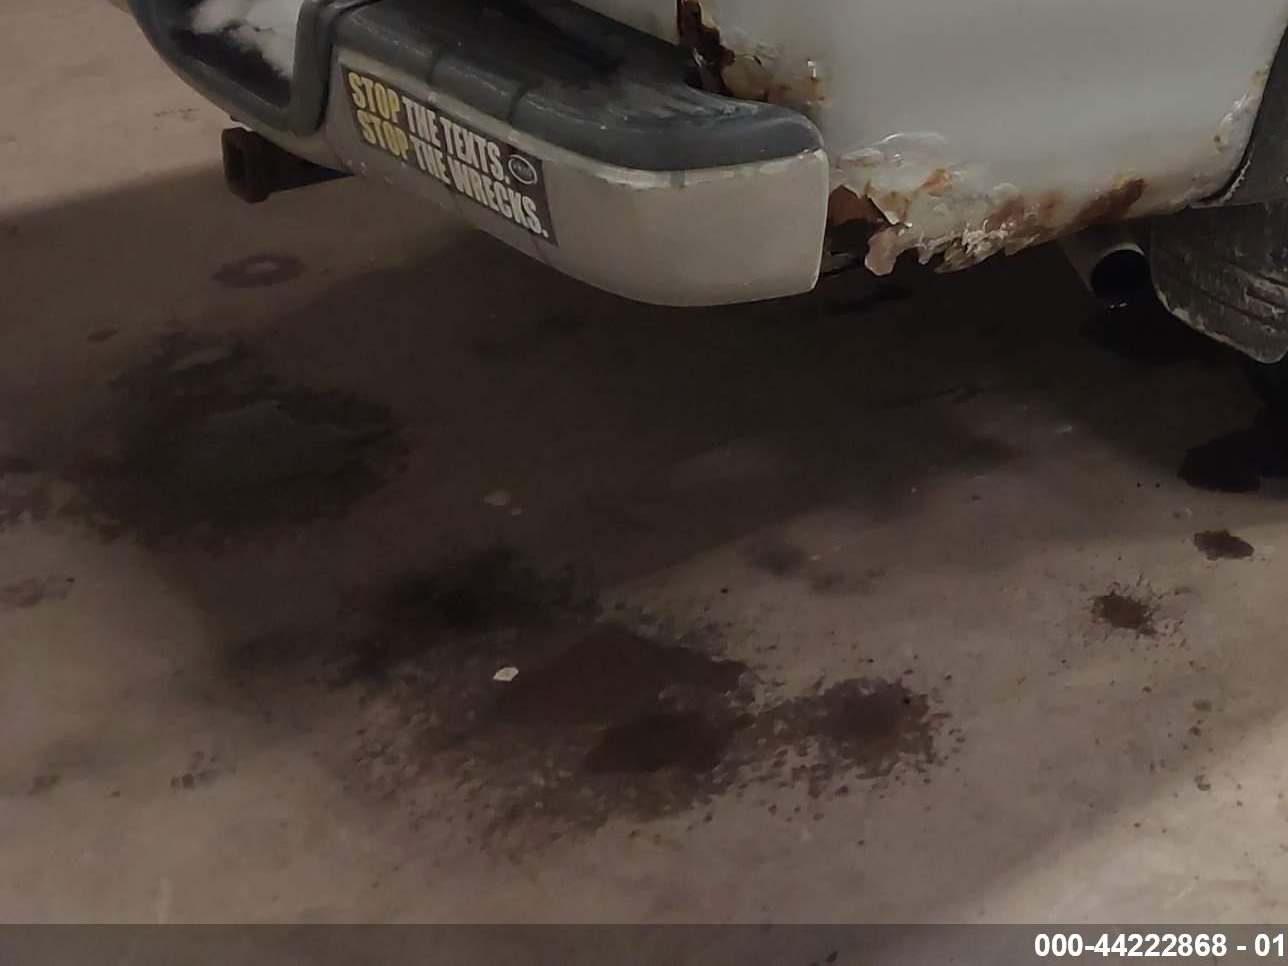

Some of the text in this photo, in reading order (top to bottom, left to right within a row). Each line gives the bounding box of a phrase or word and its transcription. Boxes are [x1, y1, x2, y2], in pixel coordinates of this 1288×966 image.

[349, 72, 401, 124] STOP
[401, 95, 441, 149] THE
[439, 115, 511, 185] TEXTS.
[356, 109, 409, 161] STOP
[409, 135, 451, 185] THE
[447, 156, 549, 239] WRECKS.
